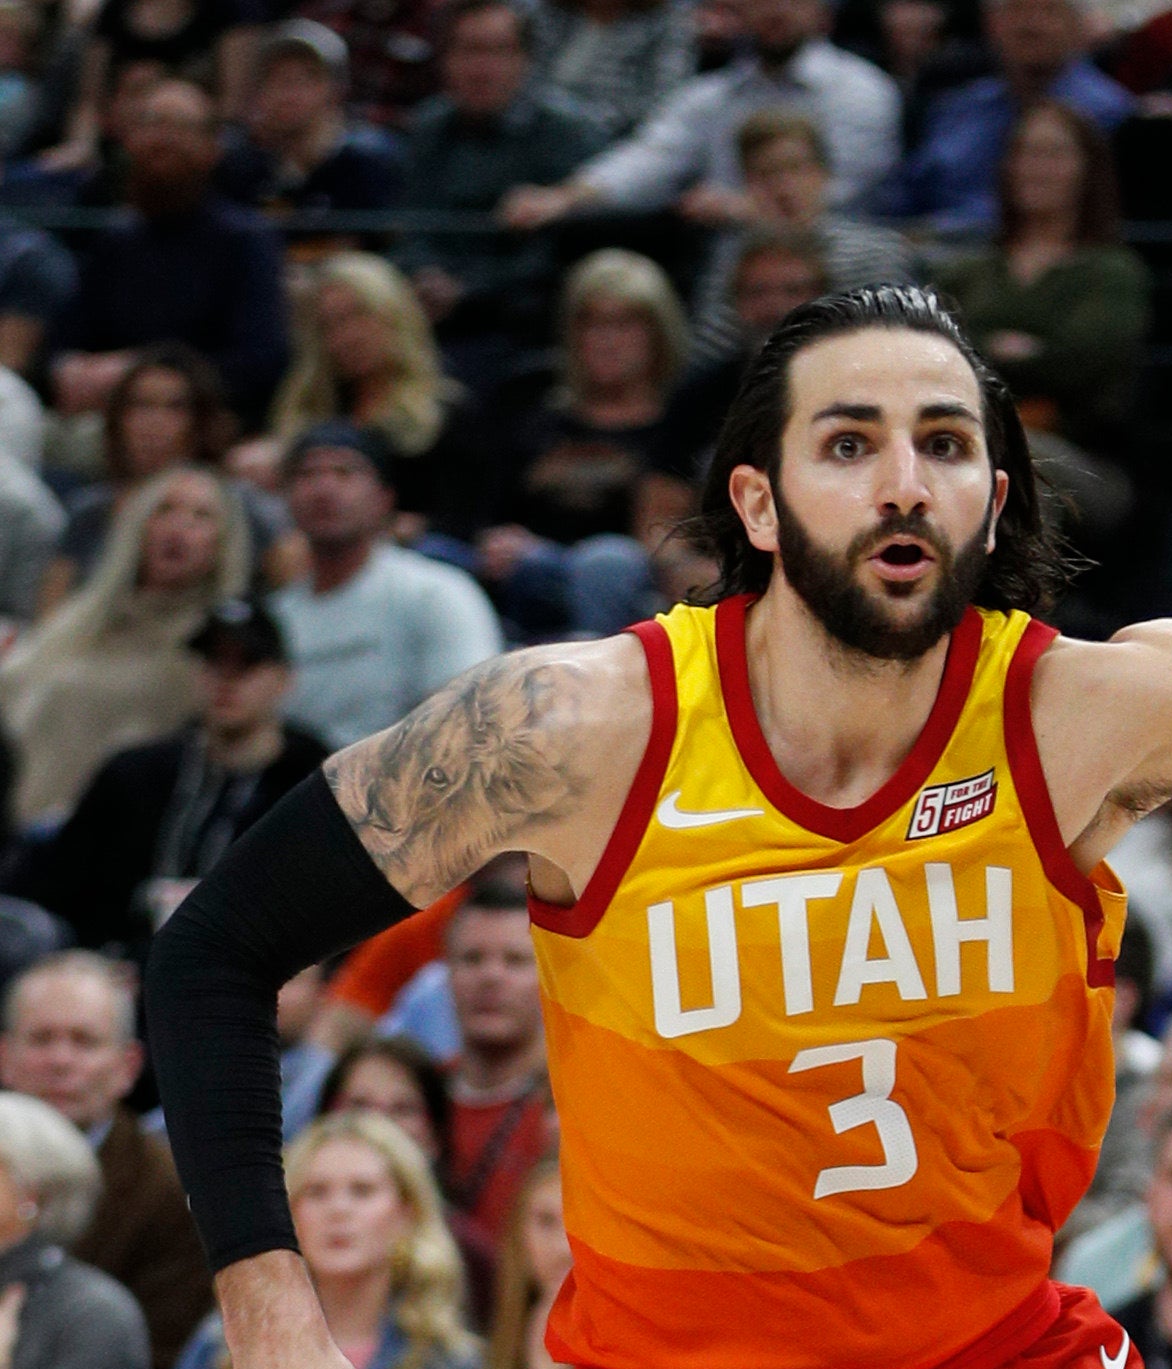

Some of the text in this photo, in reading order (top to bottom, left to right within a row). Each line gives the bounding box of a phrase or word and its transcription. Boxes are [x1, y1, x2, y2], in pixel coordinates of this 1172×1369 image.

[917, 793, 939, 832] 5
[944, 792, 993, 828] FIGHT
[950, 786, 969, 800] FOR
[647, 862, 1015, 1039] UTAH
[788, 1038, 919, 1200] 3
